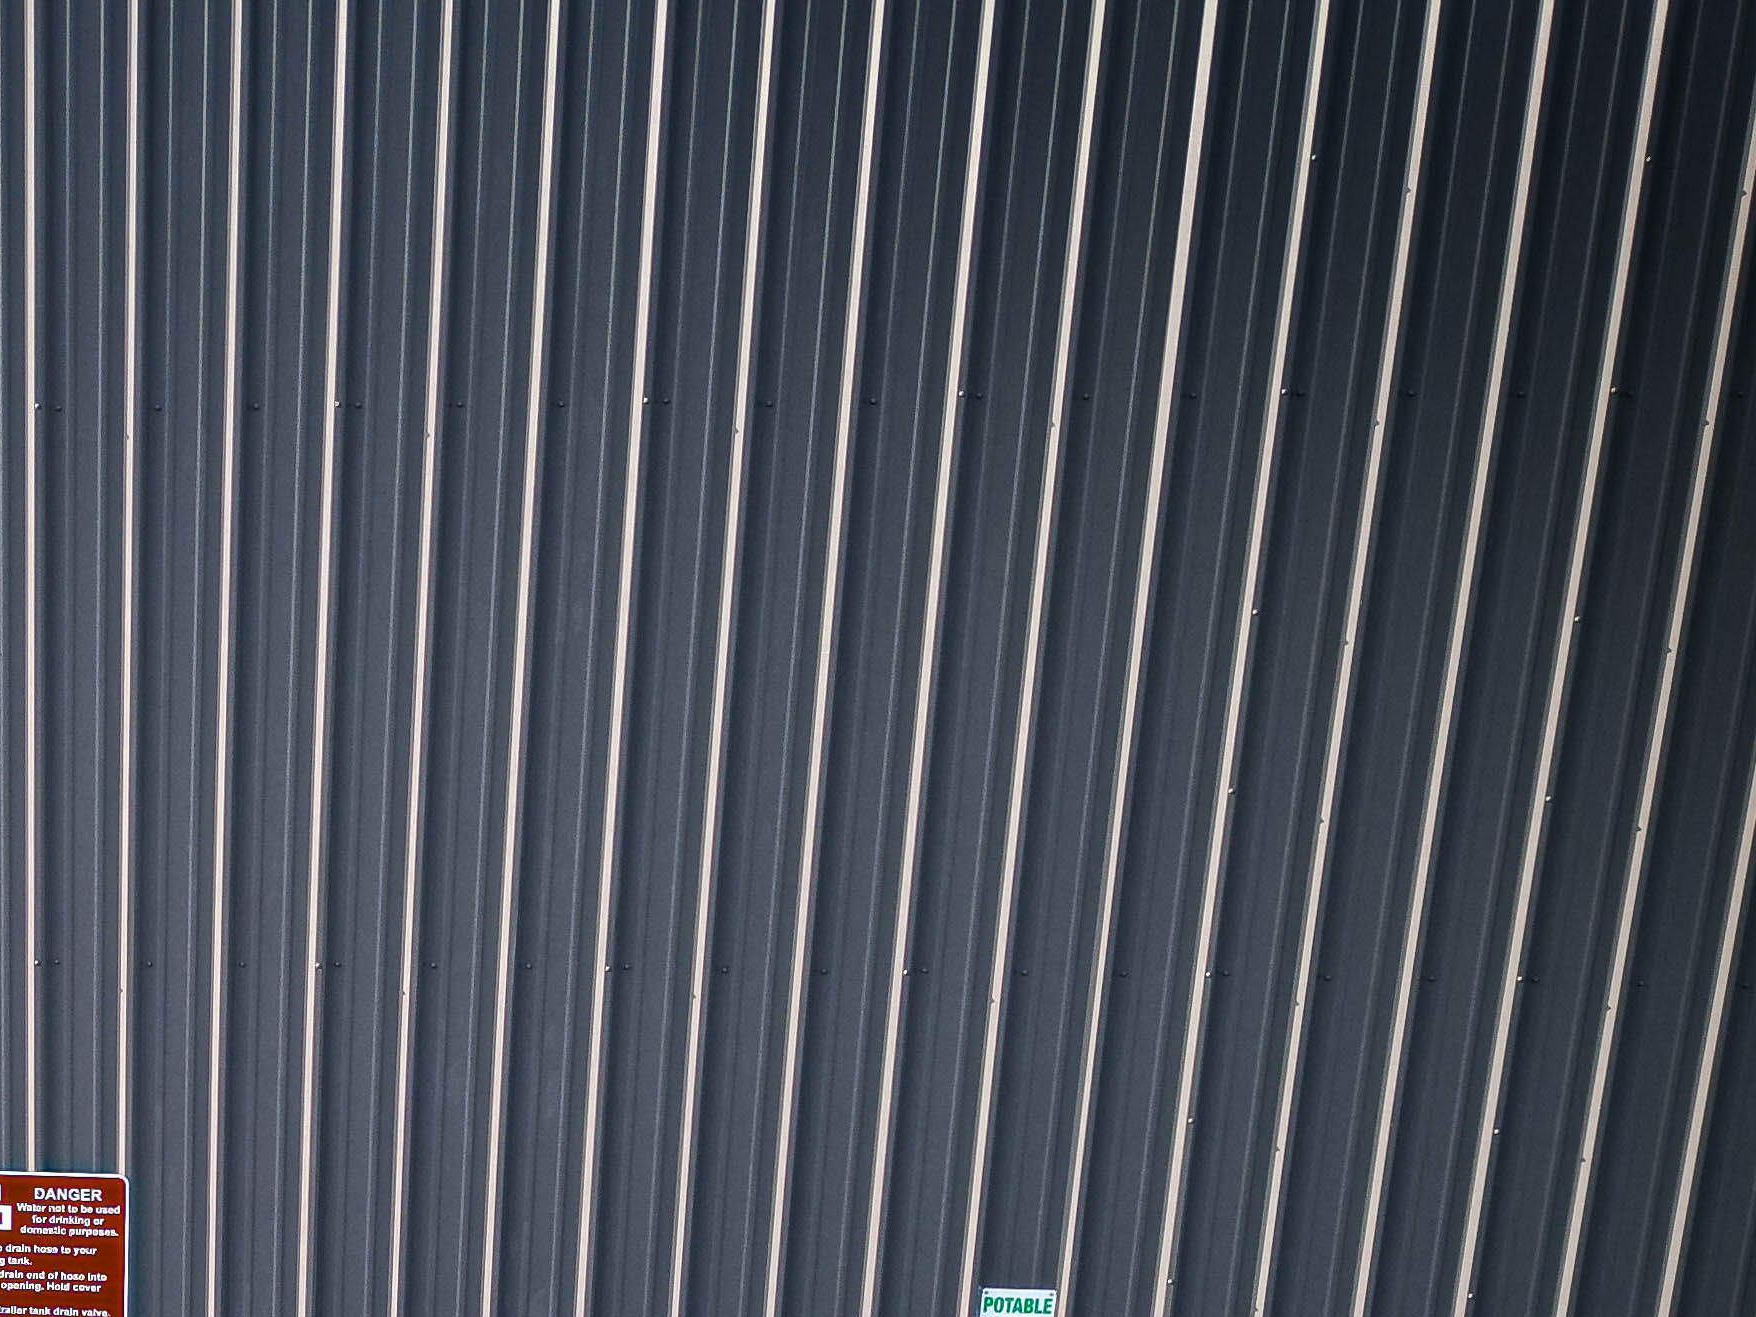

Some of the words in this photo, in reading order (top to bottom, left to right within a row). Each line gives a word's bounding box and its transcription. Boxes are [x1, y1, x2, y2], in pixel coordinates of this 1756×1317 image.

[34, 1188, 102, 1201] DANGER
[17, 1203, 46, 1212] Water
[48, 1205, 66, 1213] not
[68, 1205, 78, 1214] to
[81, 1205, 93, 1214] be
[96, 1206, 121, 1214] used
[32, 1215, 47, 1223] for
[49, 1215, 90, 1226] drinking
[20, 1225, 66, 1235] domestic
[69, 1228, 118, 1237] purposes.
[5, 1243, 31, 1253] drain
[34, 1244, 58, 1254] hose
[61, 1246, 71, 1254] to
[73, 1247, 97, 1256] your
[8, 1256, 32, 1265] tank.
[26, 1271, 45, 1280] end
[48, 1271, 59, 1280] of
[60, 1272, 85, 1280] hose
[87, 1273, 107, 1281] into
[1, 1281, 44, 1292] opening.
[46, 1282, 70, 1291] Hold
[73, 1284, 101, 1292] cover
[29, 1306, 51, 1315] tank
[53, 1307, 78, 1316] drain
[983, 1297, 1052, 1314] POTABLE
